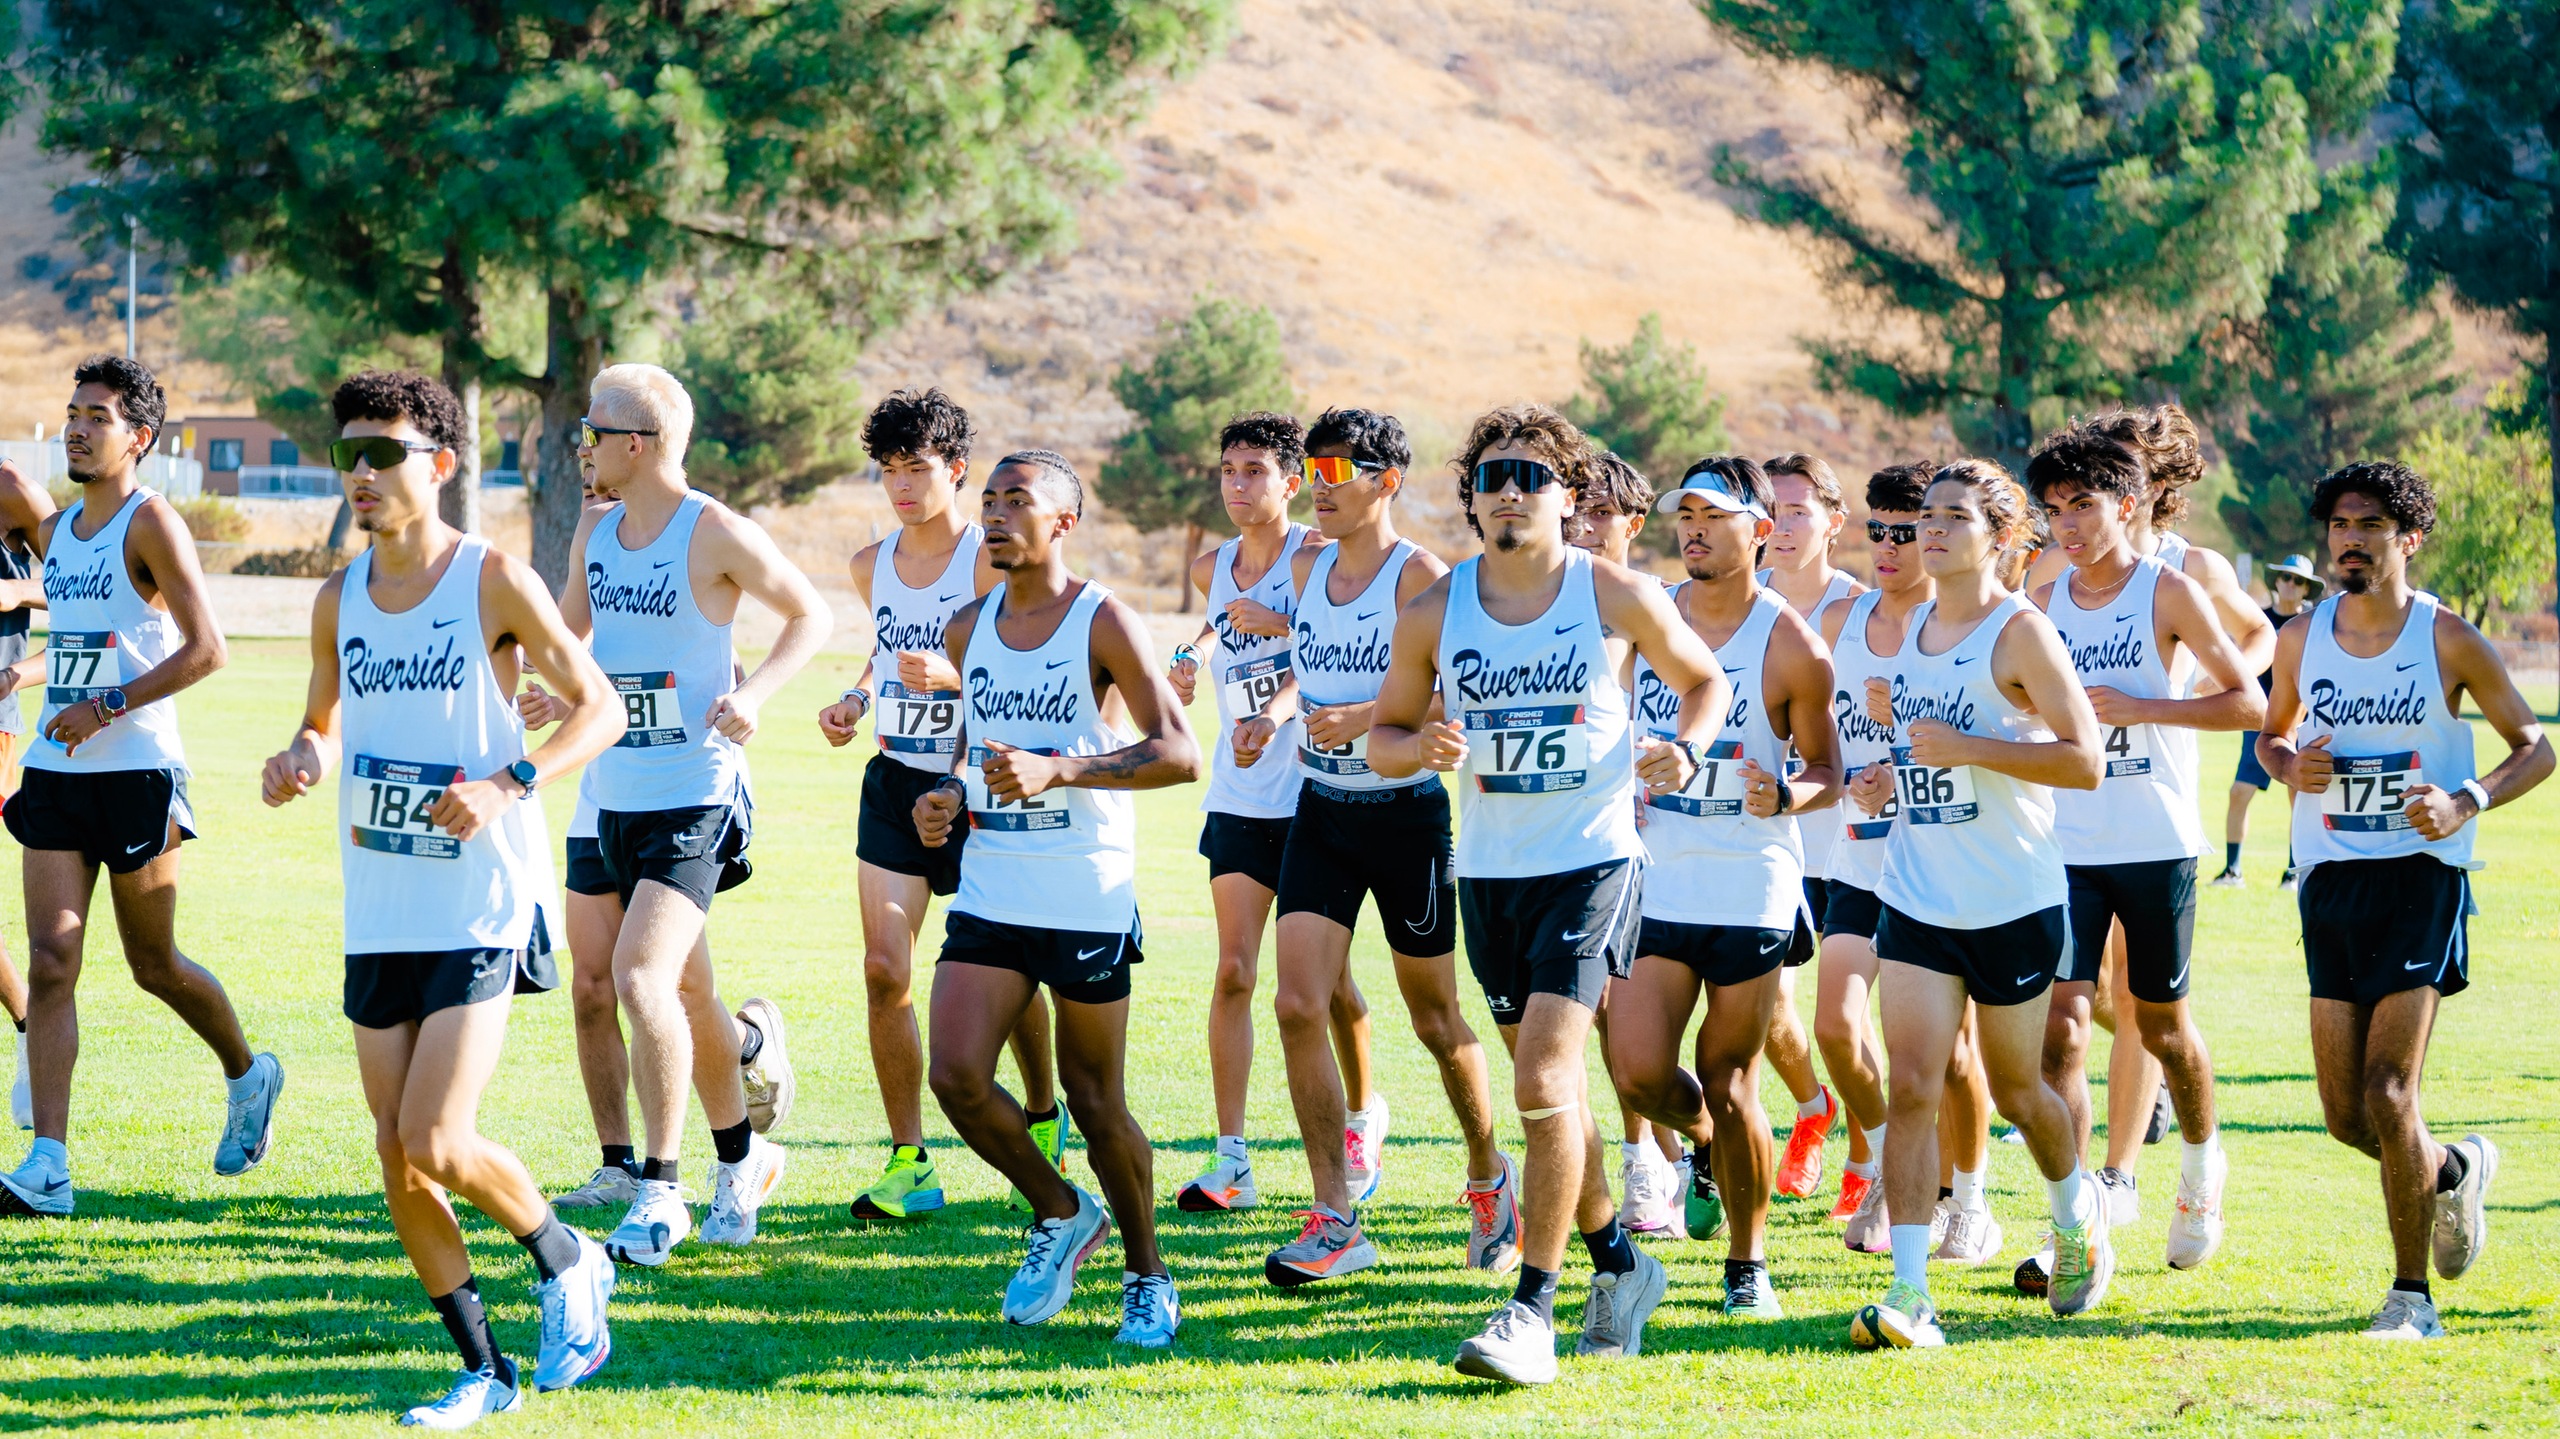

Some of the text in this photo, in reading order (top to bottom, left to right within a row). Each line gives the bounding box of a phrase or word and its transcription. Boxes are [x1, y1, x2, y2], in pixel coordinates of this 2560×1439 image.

[43, 557, 113, 600] Riverside
[588, 562, 677, 618] Riverside
[877, 606, 956, 654] Riversi
[1298, 621, 1391, 674] Riverside
[53, 651, 101, 685] 177
[344, 635, 465, 699] Riverside
[1452, 643, 1588, 704] Riverside
[619, 692, 657, 729] 81
[969, 666, 1078, 724] Riverside
[1508, 710, 1544, 718] FINISHED
[2311, 680, 2426, 729] Riverside
[897, 701, 954, 735] 179
[1507, 719, 1542, 728] RESULTS
[387, 763, 422, 774] FINISHED
[1490, 728, 1566, 772] 176
[2351, 758, 2383, 767] FINISHED
[385, 773, 420, 783] RESULTS
[1898, 767, 1954, 805] 186
[2351, 765, 2383, 774] RESULTS
[369, 783, 443, 833] 184
[1311, 781, 1396, 804] NIKE PRO
[2339, 774, 2405, 813] 175
